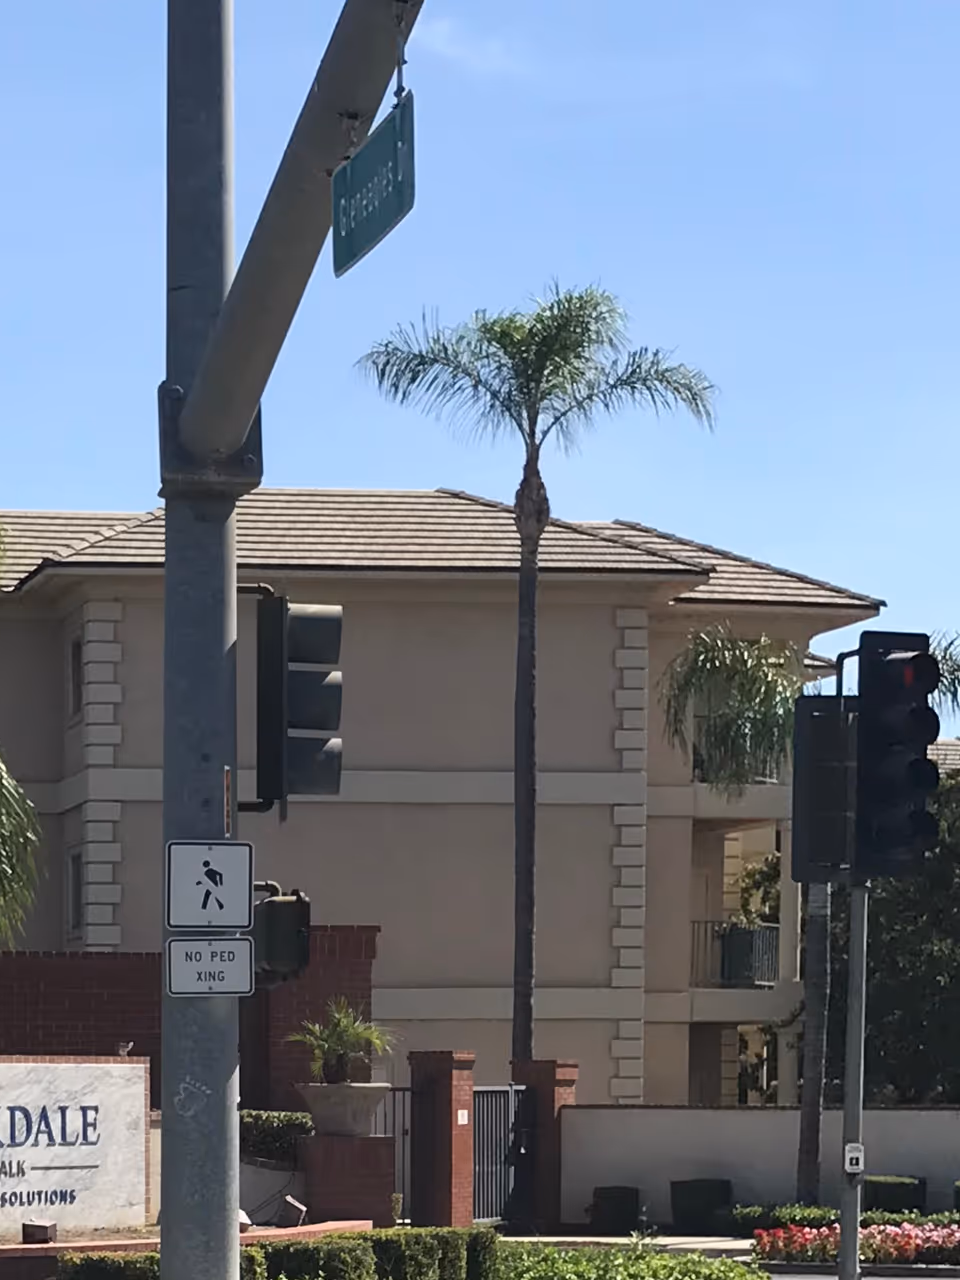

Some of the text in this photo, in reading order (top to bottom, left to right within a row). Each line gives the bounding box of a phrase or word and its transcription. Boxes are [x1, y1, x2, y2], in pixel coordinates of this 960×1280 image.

[185, 951, 235, 962] NO PED
[196, 971, 225, 982] XING
[0, 1189, 77, 1208] SOLUTIONS
